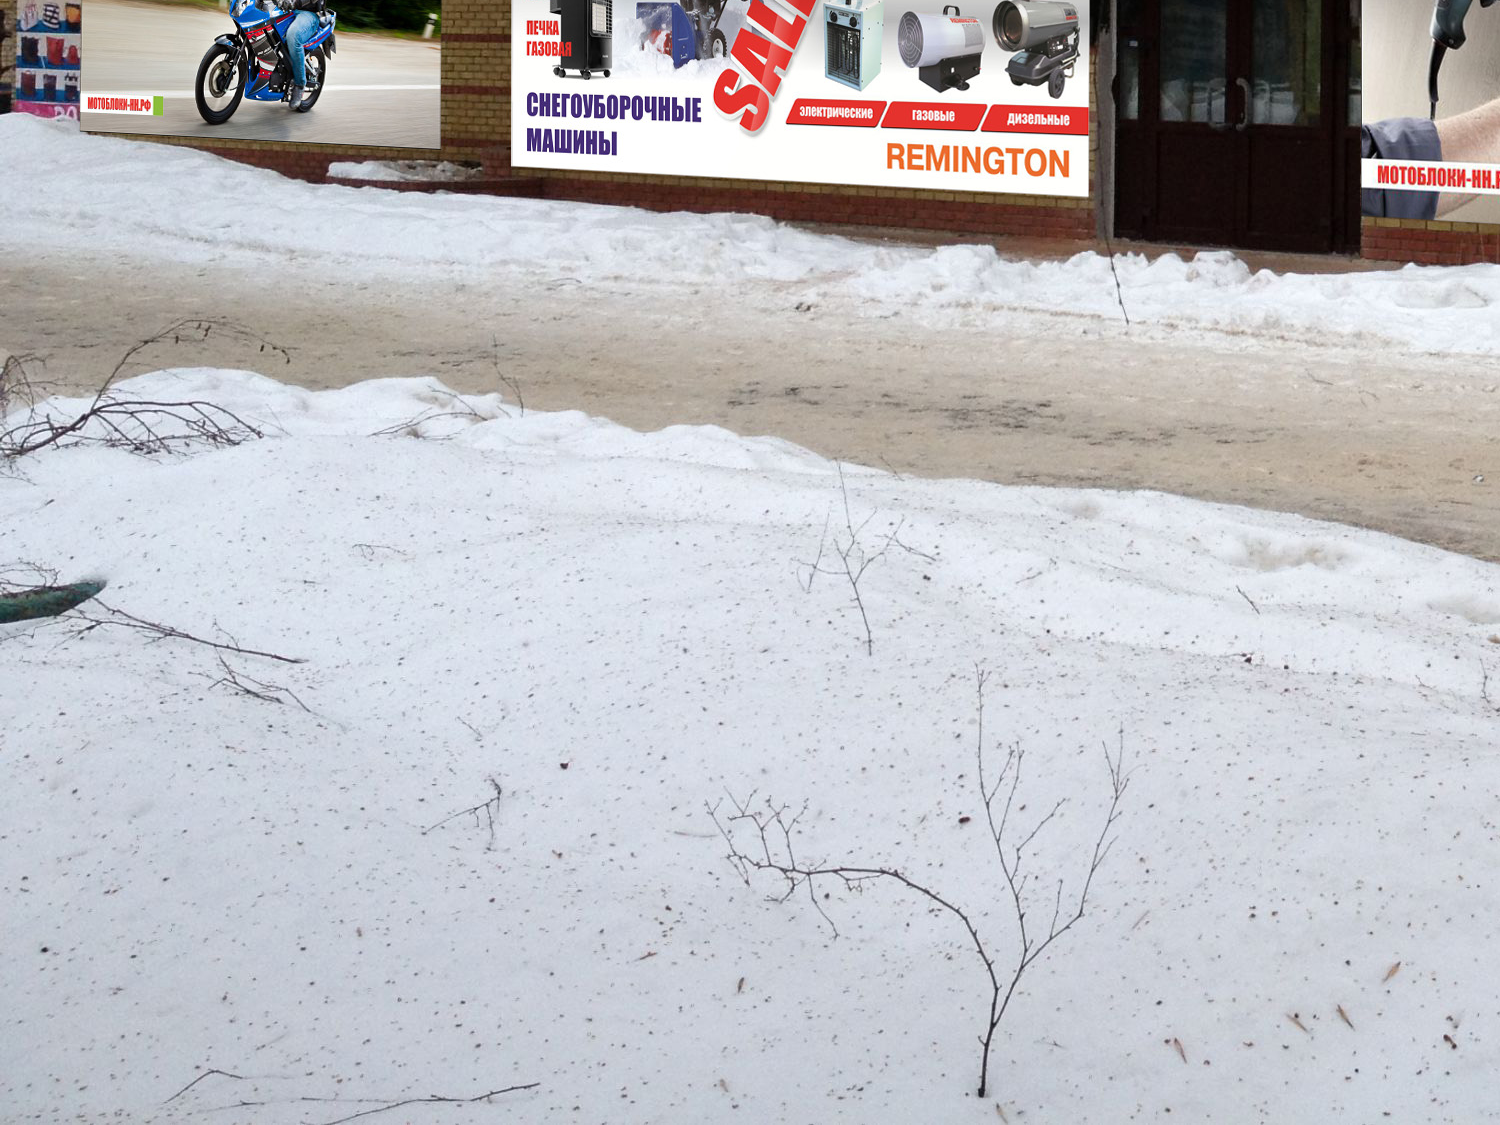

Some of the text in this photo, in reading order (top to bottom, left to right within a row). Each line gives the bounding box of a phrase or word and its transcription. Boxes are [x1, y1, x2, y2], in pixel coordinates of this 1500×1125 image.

[526, 20, 560, 36] ПЕЧКА
[526, 40, 572, 57] ГАЗОВАЯ
[87, 96, 152, 112] МОТОБЛОКИ-НН.РФ
[526, 91, 702, 123] СНЕГОУБОРОЧНЫЕ
[799, 103, 874, 120] электрические
[911, 107, 956, 123] газовые
[1007, 111, 1071, 127] дизельные
[526, 127, 618, 156] МАШИНЫ
[886, 142, 1070, 178] REMINGTON
